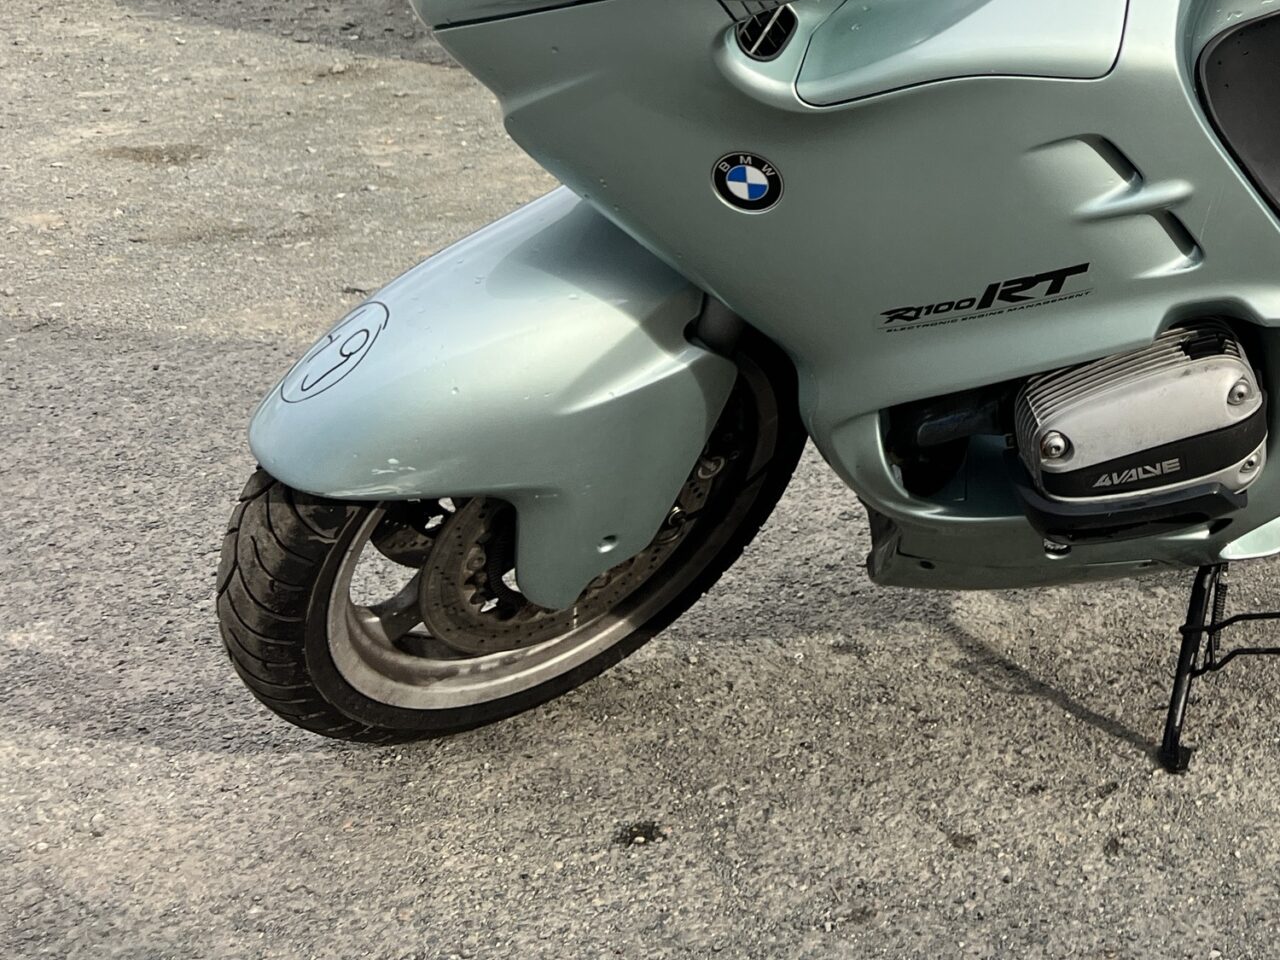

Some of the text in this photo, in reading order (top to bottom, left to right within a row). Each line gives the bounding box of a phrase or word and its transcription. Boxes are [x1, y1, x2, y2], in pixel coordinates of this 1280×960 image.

[718, 155, 776, 176] BMW
[886, 291, 1091, 333] ELECTRONIC ENGINE MANAGEMENT
